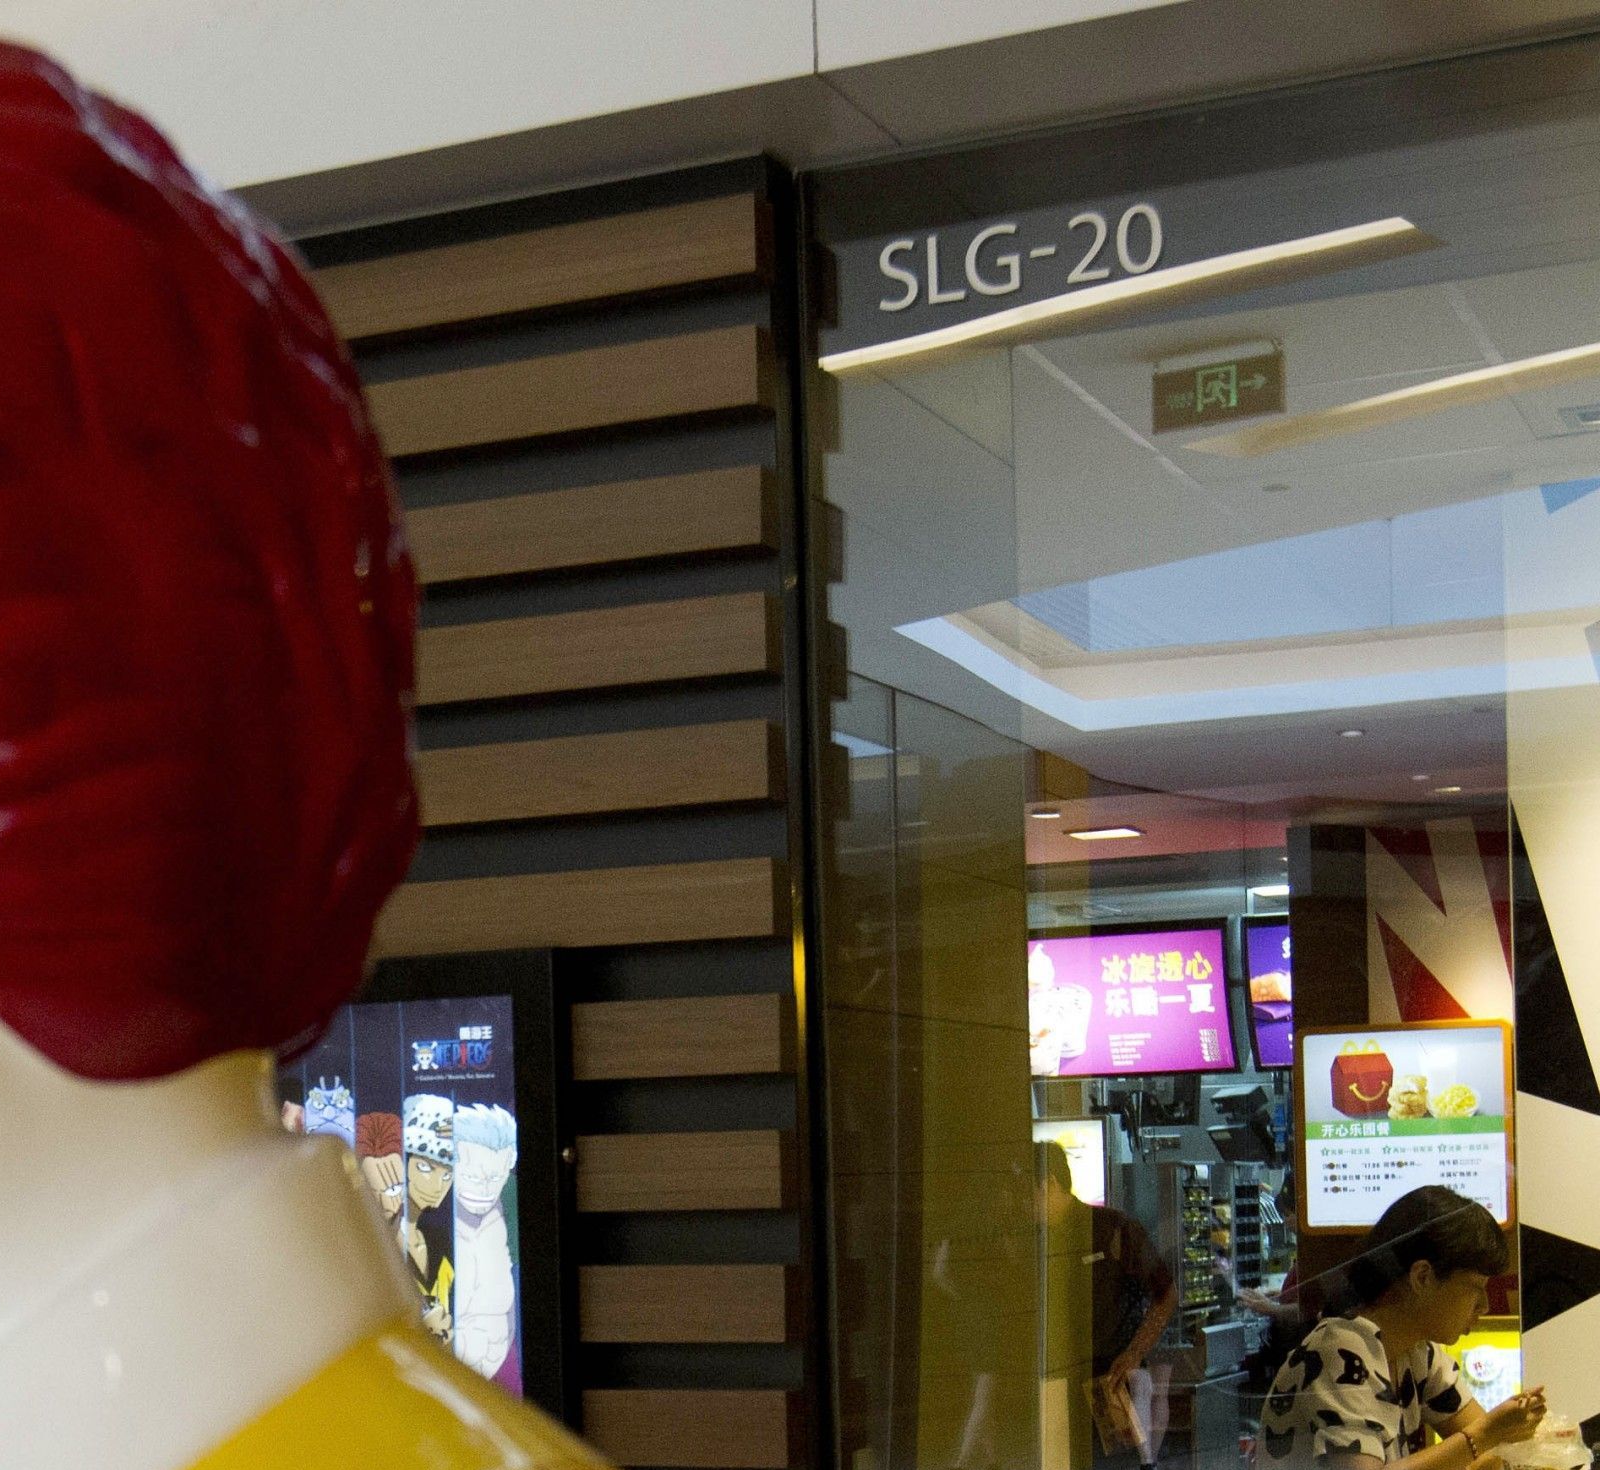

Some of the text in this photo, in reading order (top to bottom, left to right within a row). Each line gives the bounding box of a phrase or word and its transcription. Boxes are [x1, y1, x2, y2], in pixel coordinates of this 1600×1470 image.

[879, 204, 1162, 312] SLG-20
[1321, 1121, 1390, 1137] 开心乐园餐
